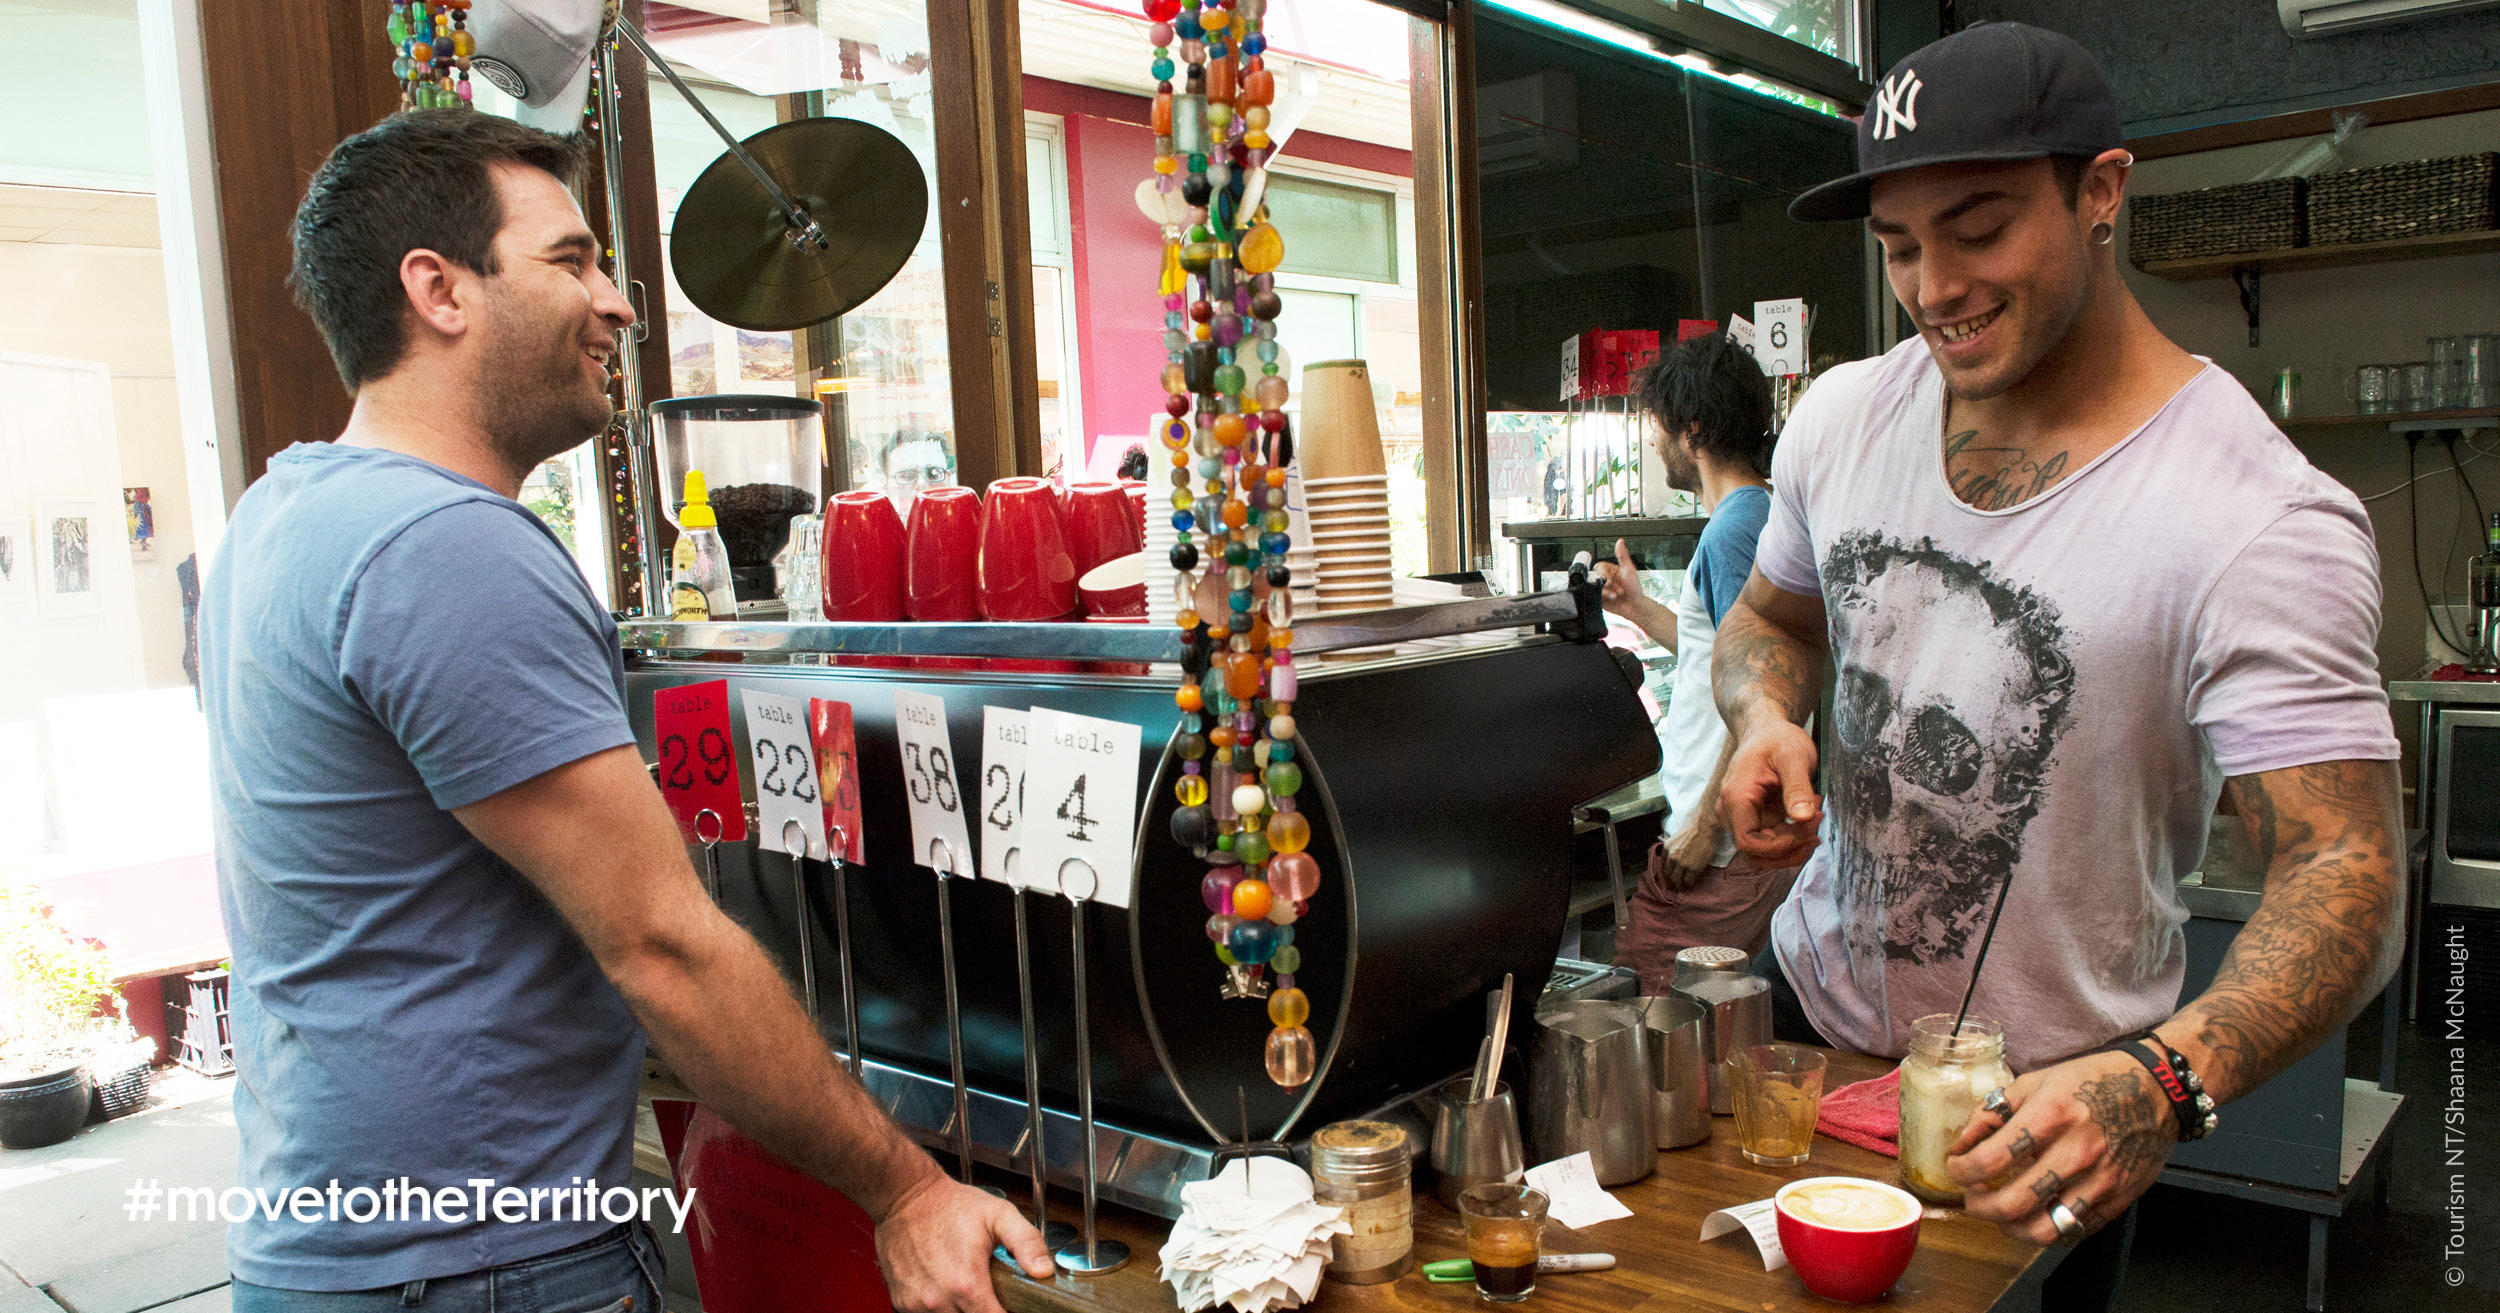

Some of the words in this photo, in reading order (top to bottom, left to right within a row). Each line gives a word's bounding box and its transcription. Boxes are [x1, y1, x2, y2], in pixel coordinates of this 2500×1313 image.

[1765, 305, 1792, 315] table
[1770, 321, 1788, 349] 6
[1562, 354, 1578, 381] 34
[671, 696, 711, 715] table
[758, 705, 794, 725] table
[905, 705, 937, 726] table
[999, 725, 1028, 746] tabl
[1054, 731, 1114, 755] table
[662, 727, 731, 791] 29
[756, 738, 816, 803] 22
[905, 741, 957, 812] 38
[987, 764, 1026, 831] 2
[1056, 773, 1099, 842] 4
